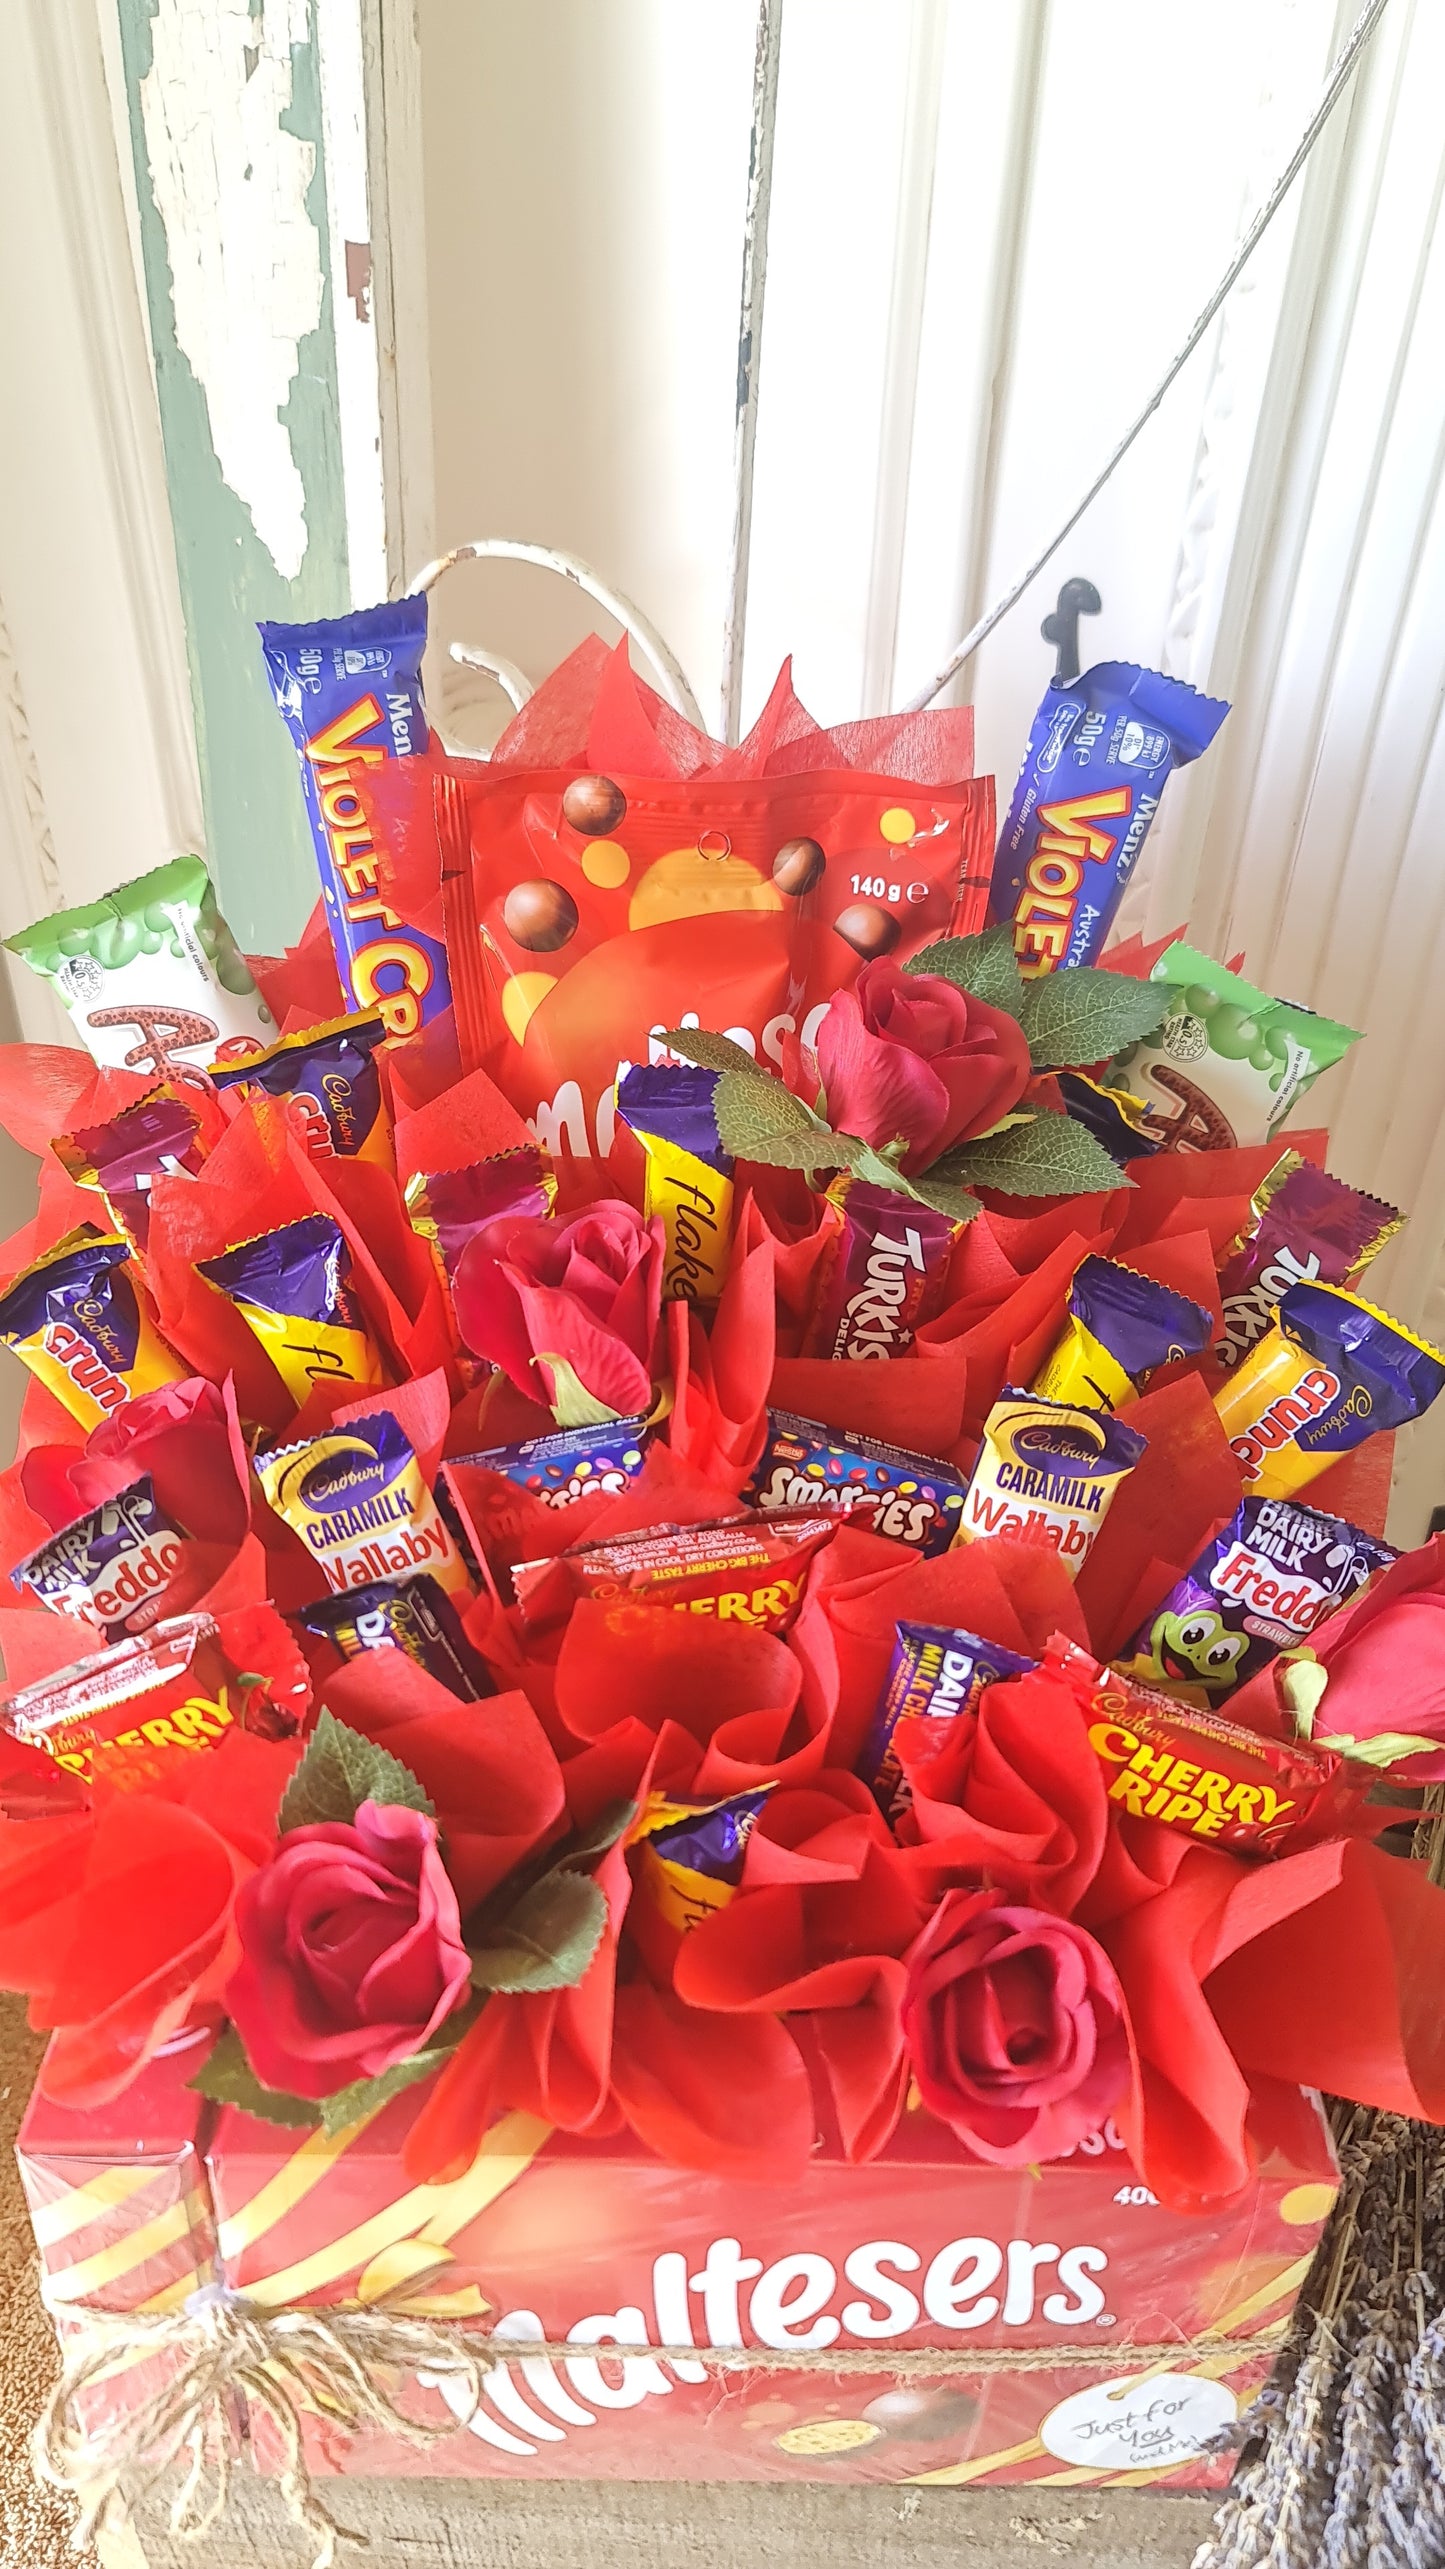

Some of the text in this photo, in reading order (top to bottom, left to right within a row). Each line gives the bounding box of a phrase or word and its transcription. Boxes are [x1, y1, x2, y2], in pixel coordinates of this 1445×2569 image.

[385, 693, 413, 757] Men
[1074, 711, 1107, 746] 50g
[1016, 787, 1038, 827] Gluten
[1117, 792, 1159, 868] Menz
[1010, 826, 1026, 851] Free
[191, 953, 209, 983] colours
[1282, 1060, 1300, 1100] artificial
[321, 1073, 355, 1147] Cadbury
[1266, 1099, 1286, 1123] colours
[72, 1299, 128, 1364] Cadbury
[1306, 1385, 1373, 1445] Cadbury
[1020, 1432, 1100, 1471] Cadbury
[308, 1462, 385, 1502] Cadbury
[996, 1461, 1106, 1513] CARAMILK
[306, 1487, 416, 1549] CARAMILK
[1256, 1506, 1334, 1555] DAIRY
[651, 1553, 771, 1581] THE BIG CHERRY TASTE
[1245, 1526, 1310, 1572] MILK
[910, 1643, 943, 1694] MILK
[1091, 1692, 1176, 1750] Cadbury
[1087, 1723, 1296, 1824] CHERRY
[1108, 1769, 1233, 1838] RIPE
[415, 2236, 1109, 2457] Maltesers
[1071, 2412, 1135, 2440] Just
